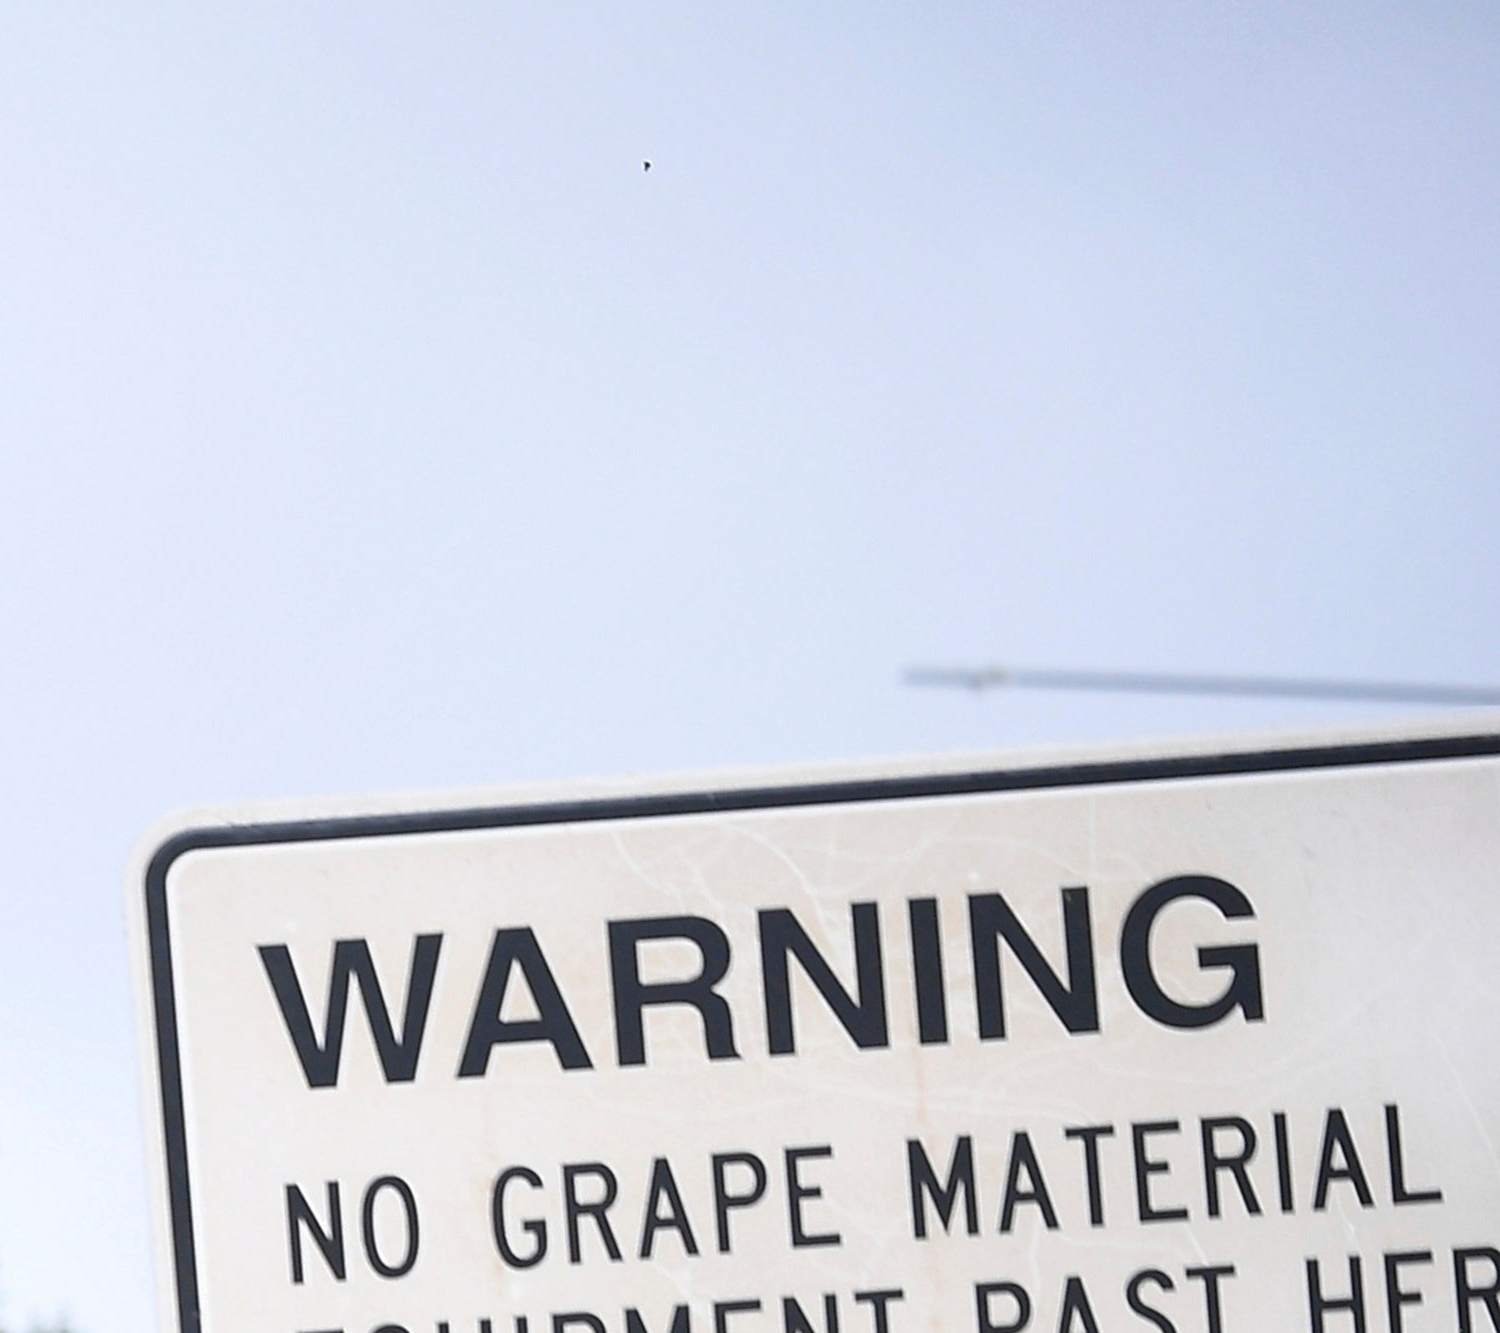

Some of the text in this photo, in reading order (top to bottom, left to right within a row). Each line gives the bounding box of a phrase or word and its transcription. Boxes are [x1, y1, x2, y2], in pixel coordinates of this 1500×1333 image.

[257, 873, 1266, 1089] WARNING
[285, 1103, 1443, 1285] NO GRAPE MATERIAL
